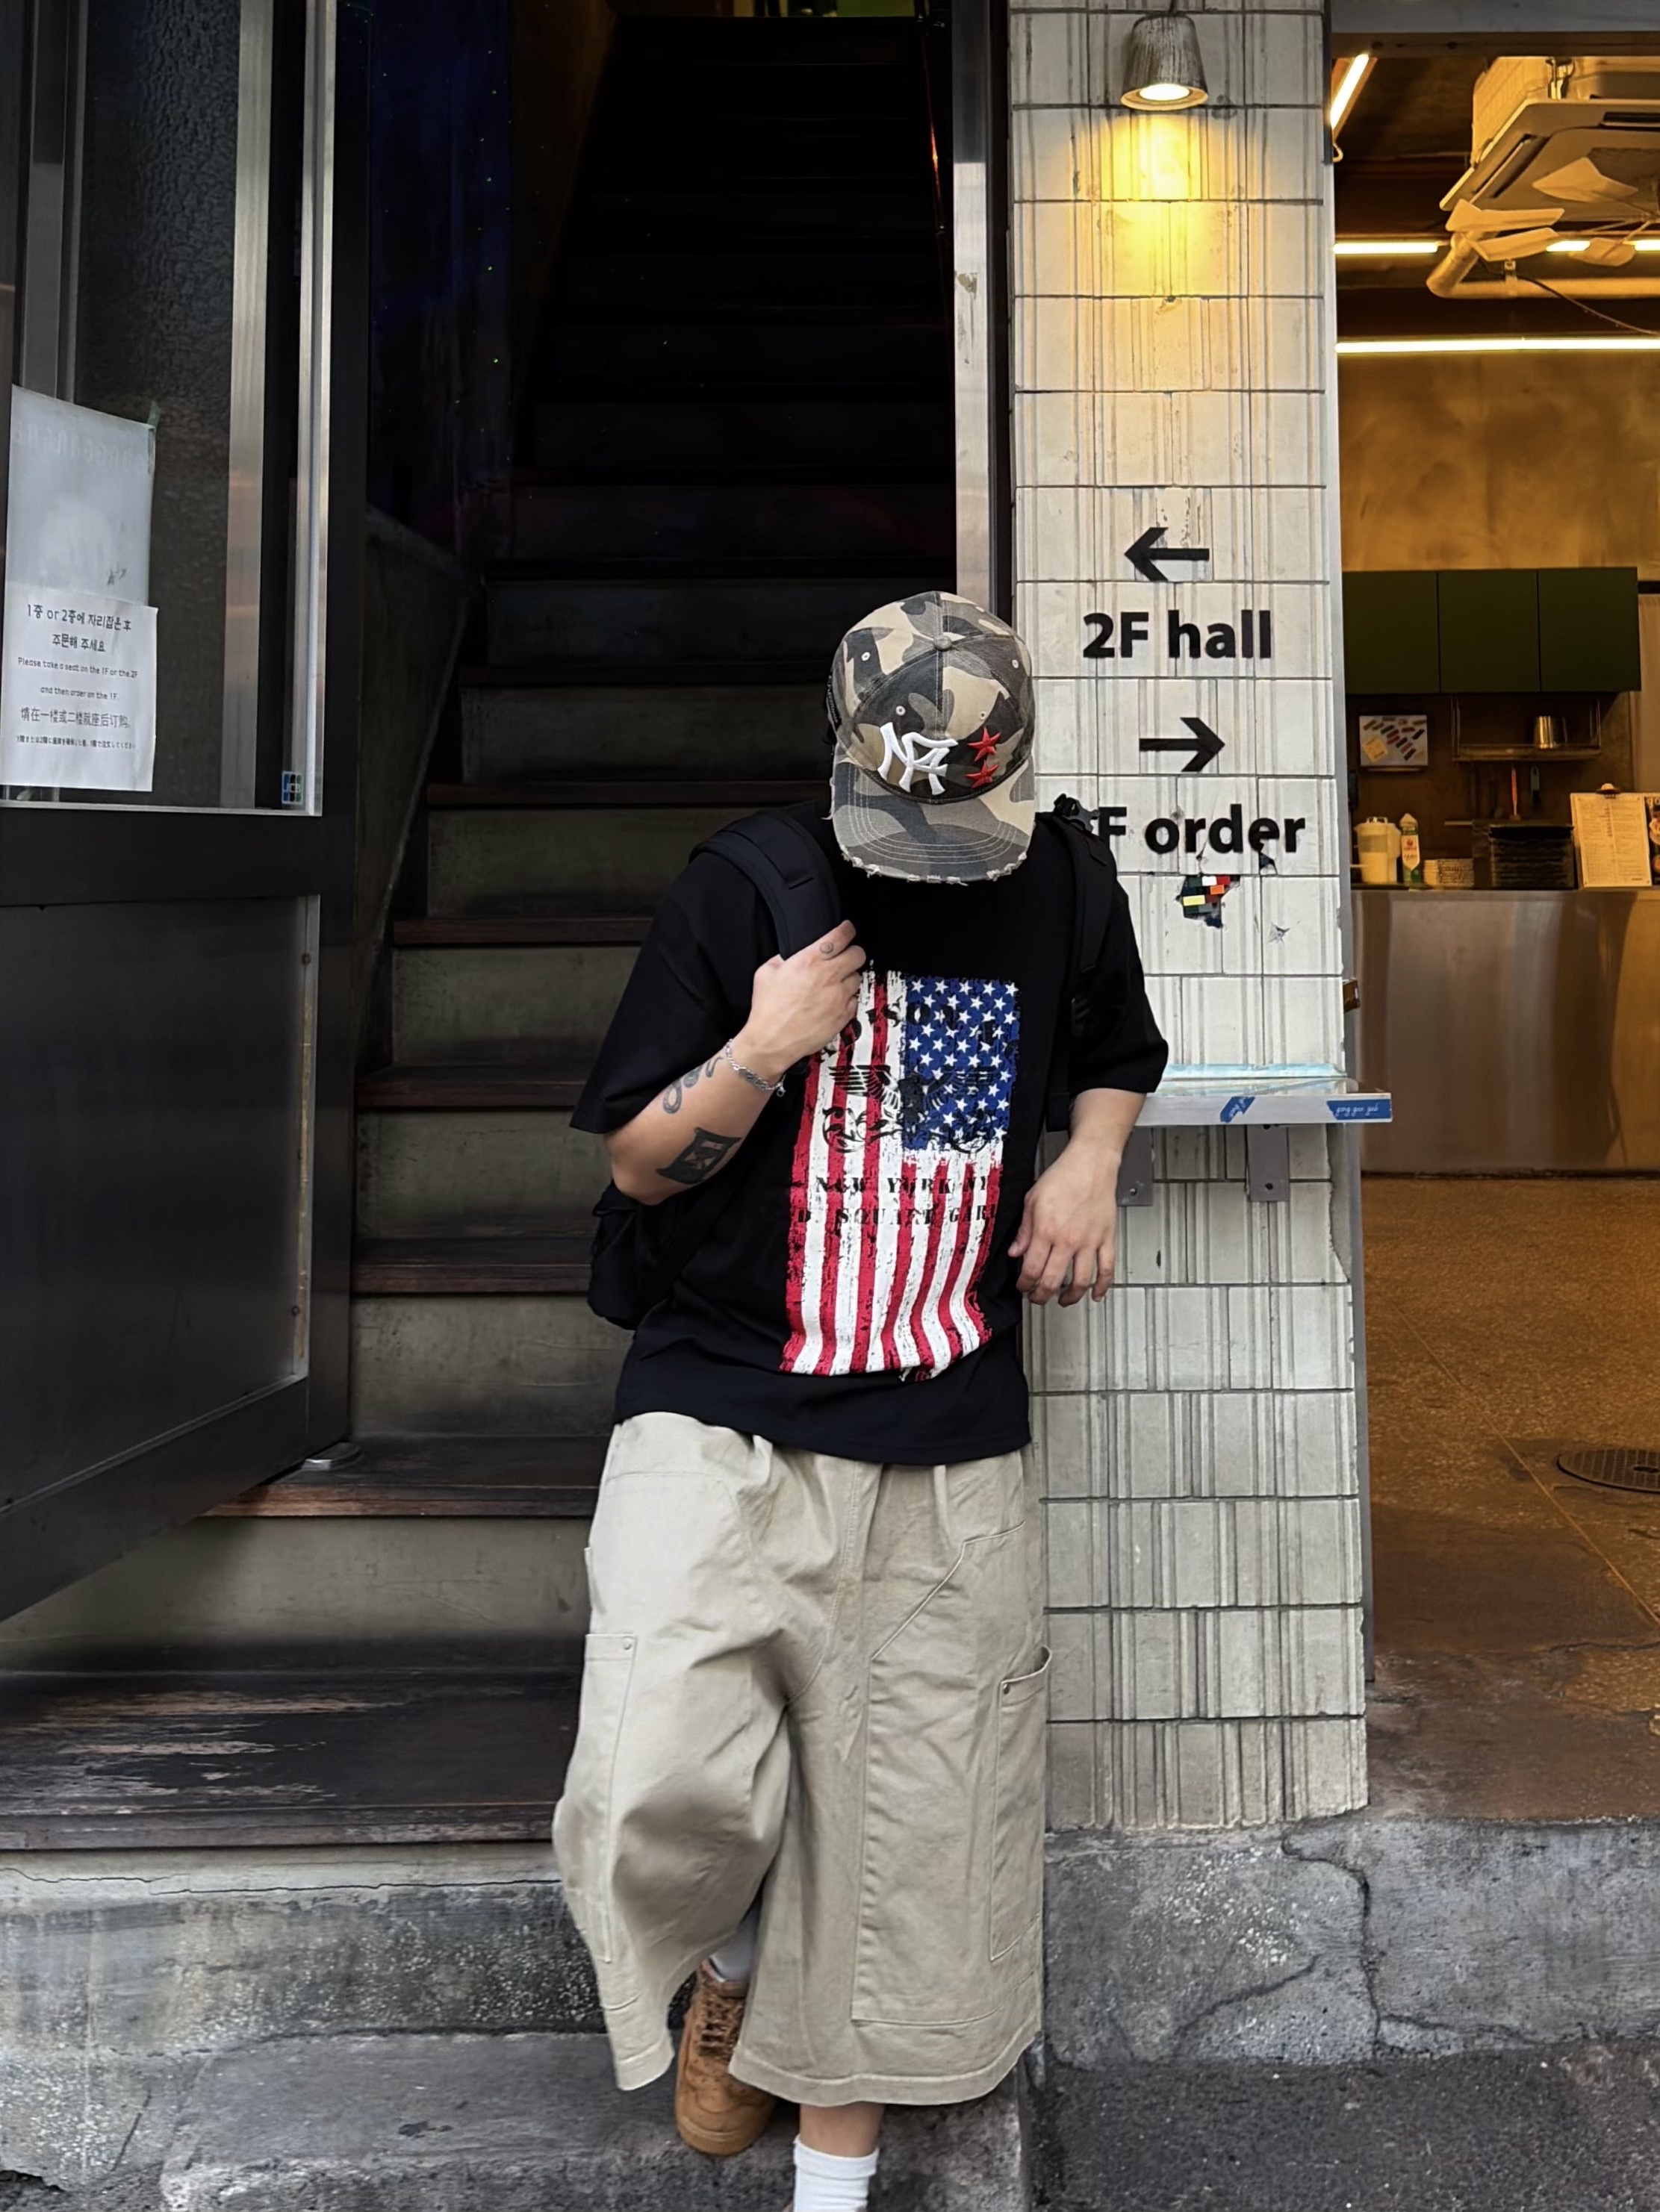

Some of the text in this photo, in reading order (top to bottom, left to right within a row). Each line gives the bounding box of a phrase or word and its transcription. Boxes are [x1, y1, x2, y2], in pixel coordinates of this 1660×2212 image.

[47, 610, 59, 620] or
[52, 633, 105, 652] 주문해 주세요
[1083, 609, 1271, 659] 2F hall
[18, 657, 41, 667] Please
[43, 660, 58, 669] take
[90, 666, 100, 674] the
[55, 687, 69, 696] then
[96, 691, 108, 700] the
[1098, 803, 1307, 854] F order
